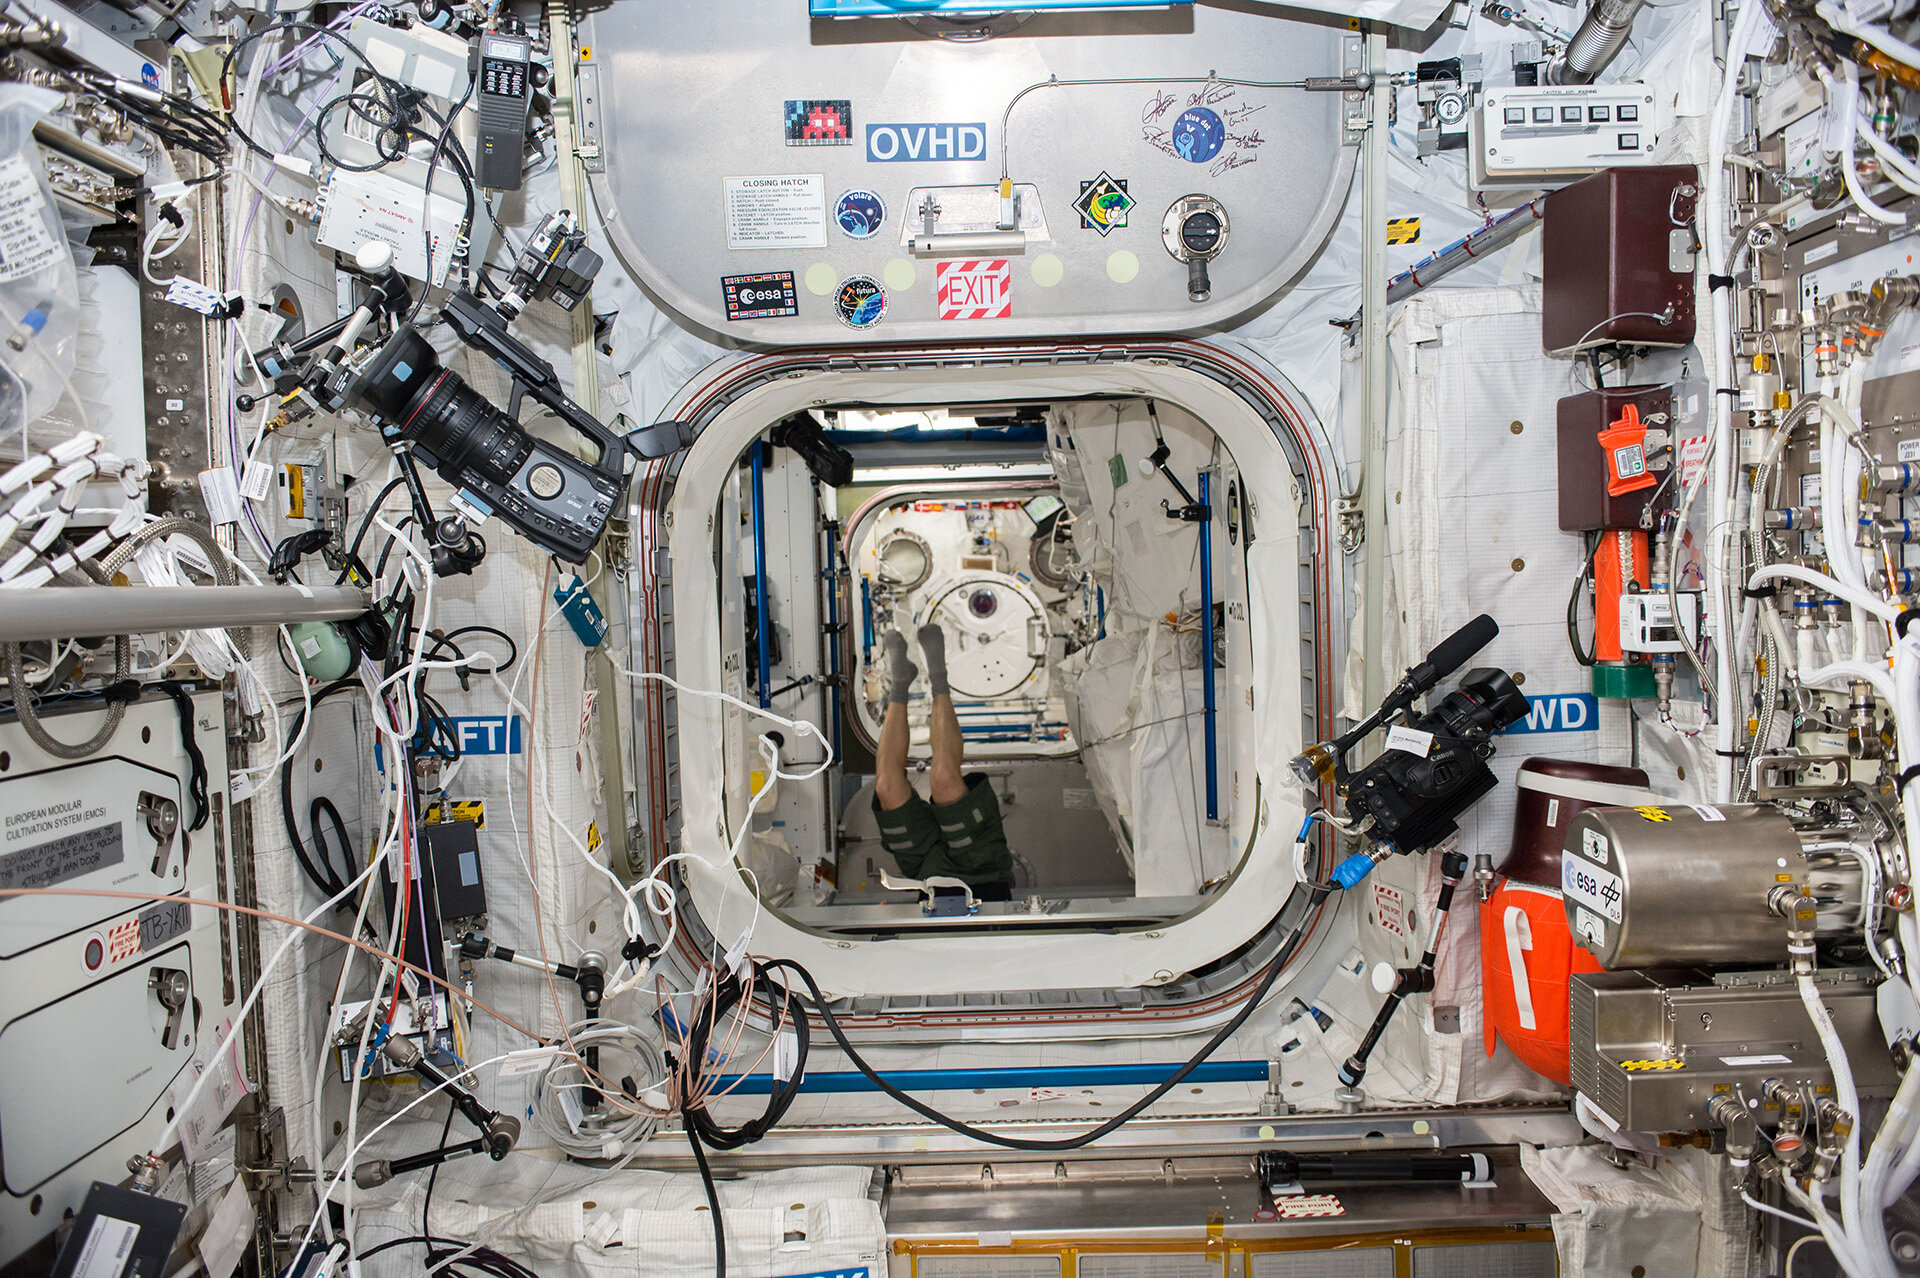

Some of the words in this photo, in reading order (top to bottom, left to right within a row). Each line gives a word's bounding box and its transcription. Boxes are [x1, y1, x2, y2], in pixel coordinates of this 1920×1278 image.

[1185, 113, 1200, 122] blue
[1201, 119, 1211, 131] dot
[870, 127, 984, 160] OVHD
[849, 192, 872, 201] volare
[387, 210, 406, 220] AMSAT
[1886, 268, 1898, 277] DATA
[949, 274, 998, 305] EXIT
[1851, 280, 1863, 290] DATA
[181, 290, 207, 302] ATTENTION
[756, 289, 782, 301] esa
[1900, 440, 1919, 450] POWER
[1524, 698, 1587, 730] WD
[428, 721, 503, 752] AFT
[1430, 750, 1455, 762] Canon
[5, 808, 46, 827] EUROPEAN
[48, 800, 82, 815] MODULAR
[6, 821, 53, 841] CULTIVATION
[54, 813, 82, 828] SYSTEM
[83, 807, 106, 822] (EMCS)
[4, 857, 16, 868] DO
[21, 850, 36, 861] NOT
[38, 840, 66, 856] ATTACH
[68, 835, 81, 846] ANY
[83, 830, 100, 842] ITEMS
[104, 826, 113, 835] TO
[17, 860, 42, 873] FRONT
[45, 855, 55, 867] OF
[58, 849, 71, 859] THE
[72, 842, 94, 855] EMCS
[97, 834, 122, 848] HOLDING
[21, 867, 61, 888] STRUCTURE
[80, 852, 101, 866] DOOR
[1577, 871, 1597, 897] esa
[1610, 908, 1620, 919] DLR
[124, 935, 136, 944] PORT
